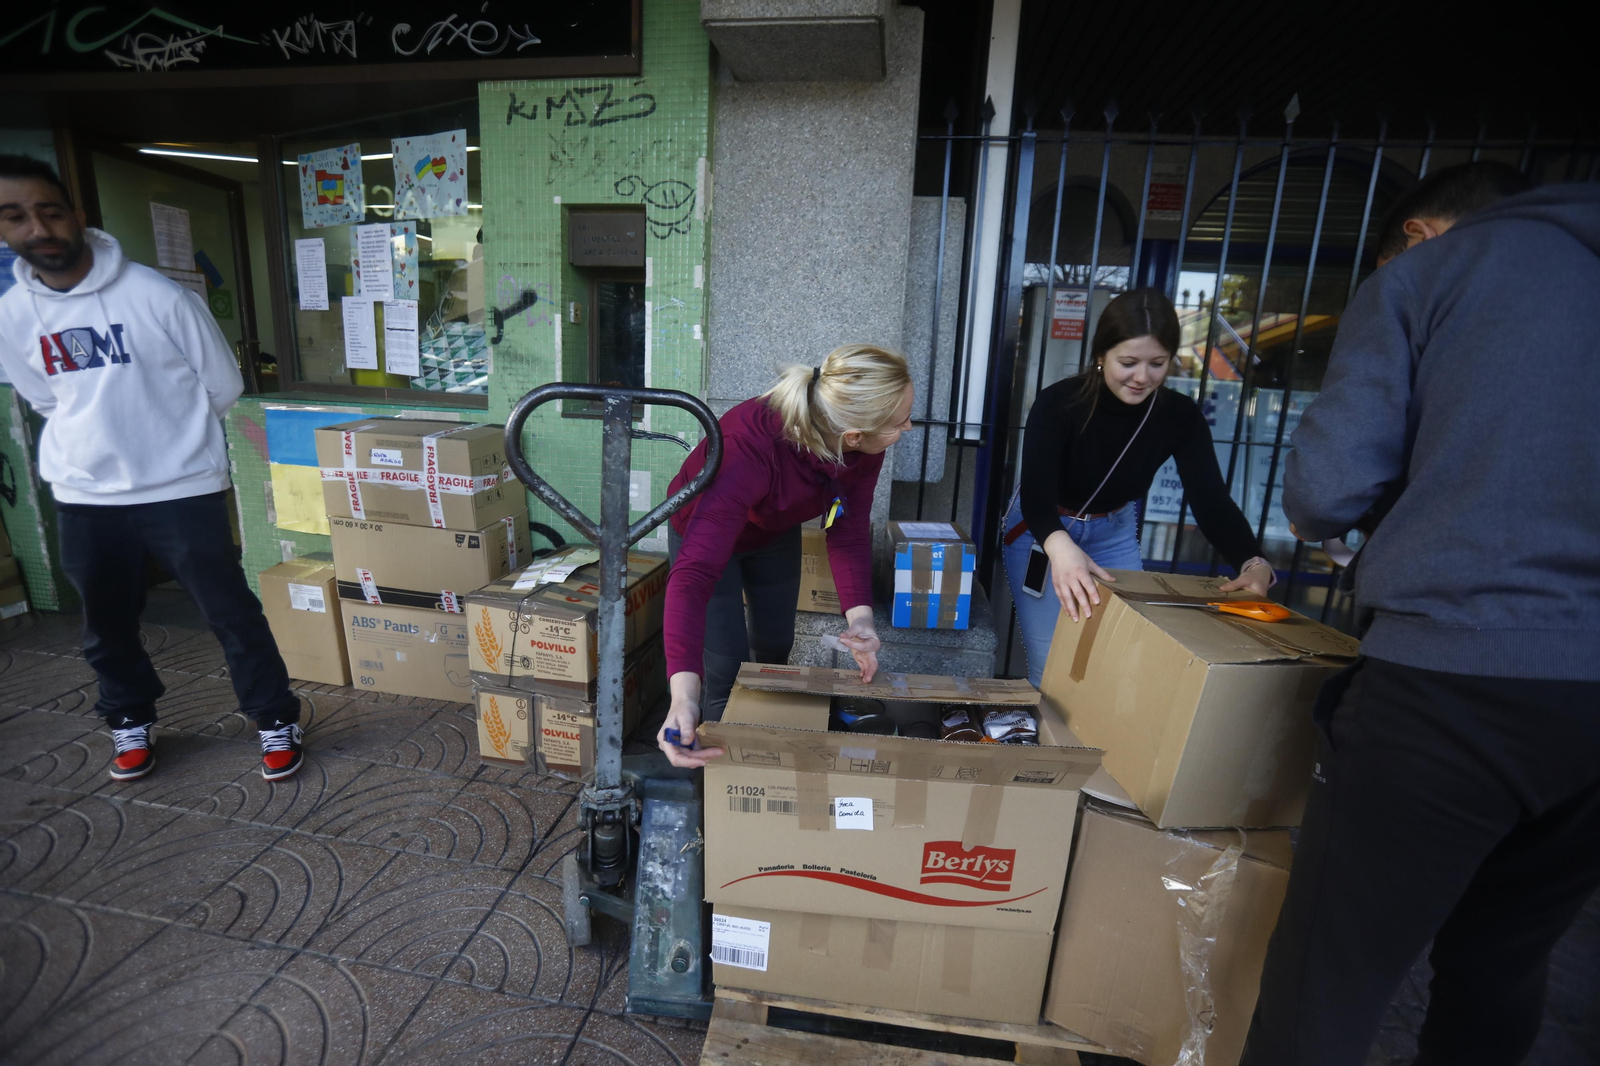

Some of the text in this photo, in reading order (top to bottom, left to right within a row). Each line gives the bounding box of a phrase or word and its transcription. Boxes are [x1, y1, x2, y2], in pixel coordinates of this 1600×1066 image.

[381, 471, 419, 482] FRAGILE
[438, 476, 474, 488] RAGILE
[1152, 495, 1172, 505] 957
[360, 522, 368, 530] 30
[375, 524, 383, 532] 30
[383, 619, 419, 634] Pants
[440, 625, 448, 635] G
[531, 639, 577, 655] POLVILLO
[360, 675, 375, 686] 80
[727, 785, 765, 796] 211024
[925, 850, 1011, 880] Berlys
